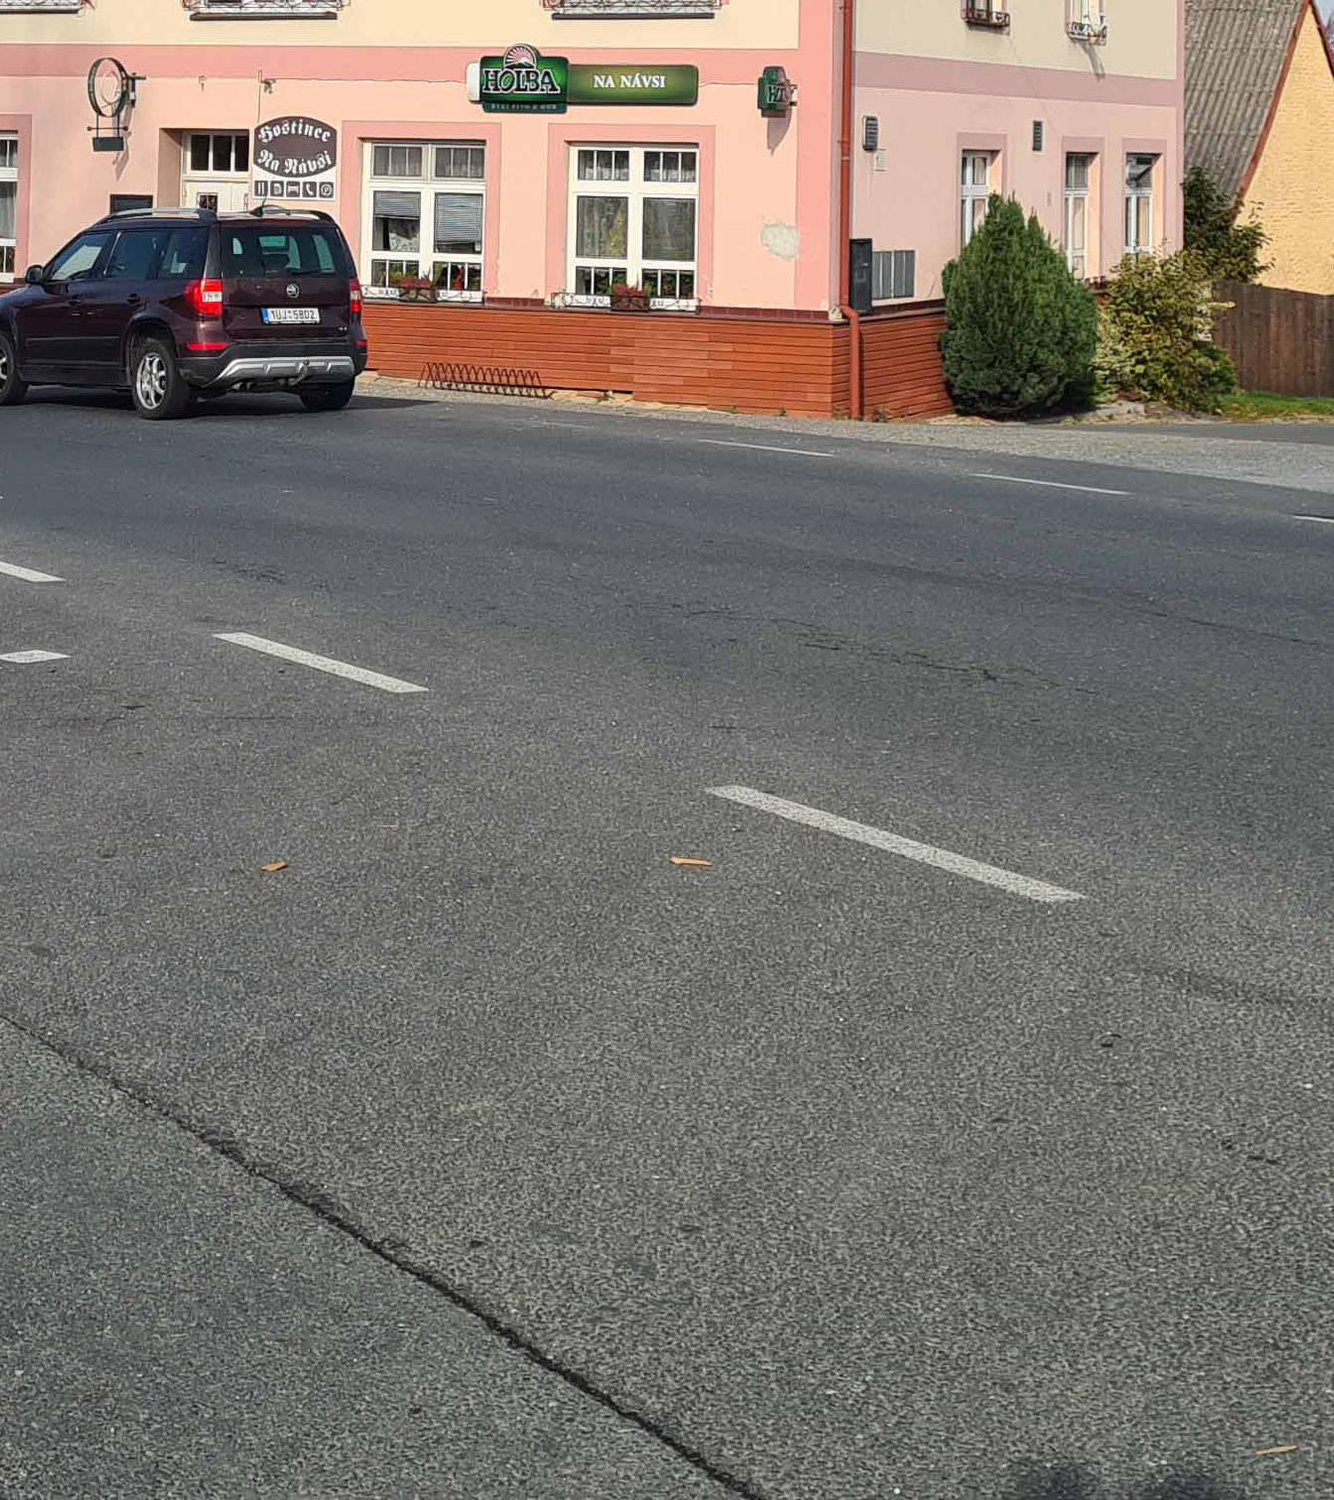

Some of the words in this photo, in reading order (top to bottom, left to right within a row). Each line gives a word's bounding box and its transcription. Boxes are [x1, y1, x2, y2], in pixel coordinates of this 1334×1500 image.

[482, 68, 561, 94] HOLBA
[593, 75, 616, 88] NA
[620, 73, 667, 88] NÁVSI
